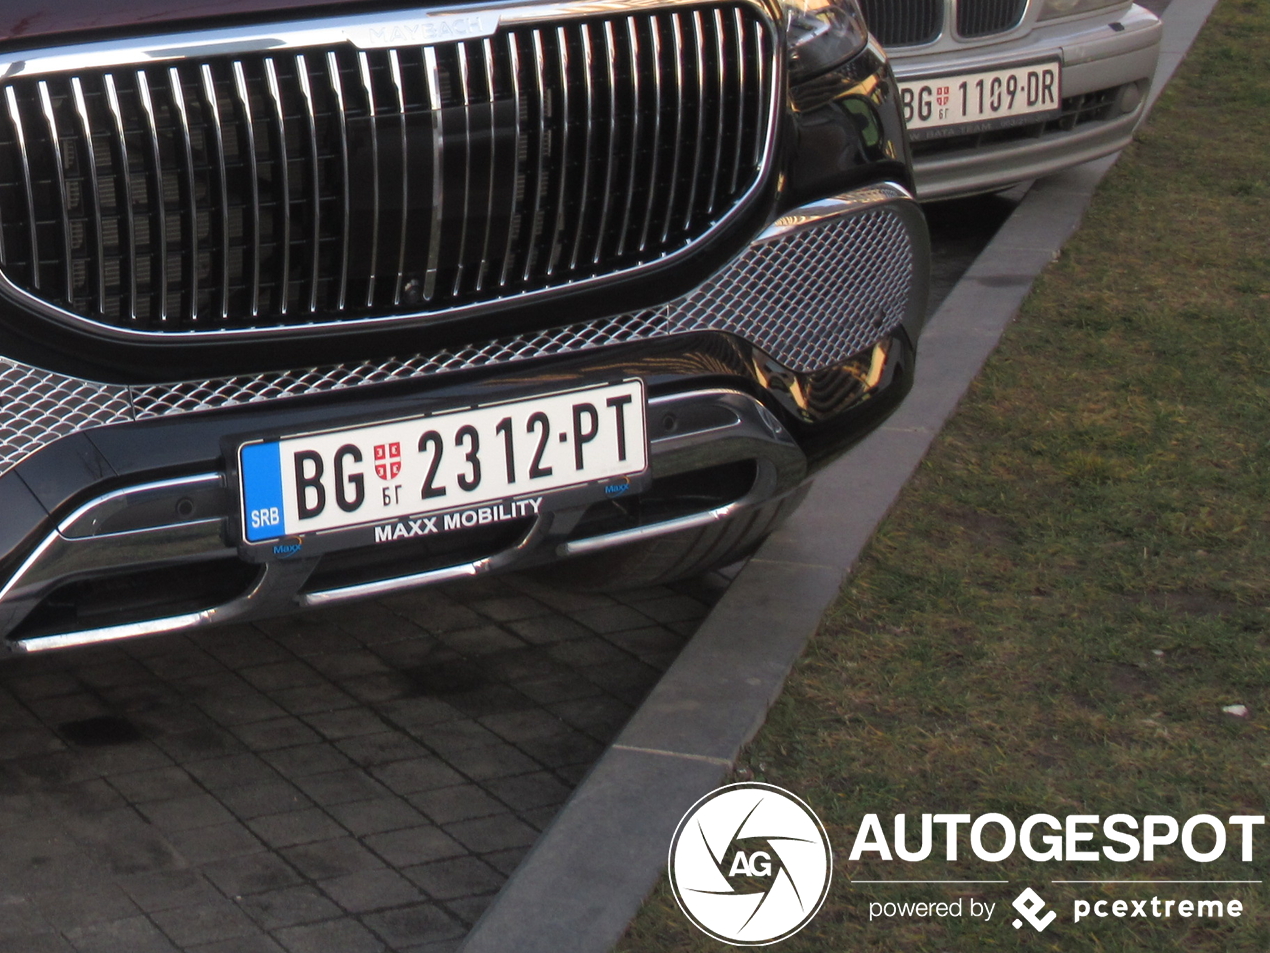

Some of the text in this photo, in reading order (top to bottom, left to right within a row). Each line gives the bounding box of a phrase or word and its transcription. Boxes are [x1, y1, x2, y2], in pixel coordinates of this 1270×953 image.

[368, 16, 483, 44] MAYBACH
[899, 85, 932, 123] BG
[293, 443, 365, 521] BG
[251, 506, 280, 528] SRB
[374, 497, 543, 543] MAXX MOBILITY
[273, 543, 302, 555] Maxx
